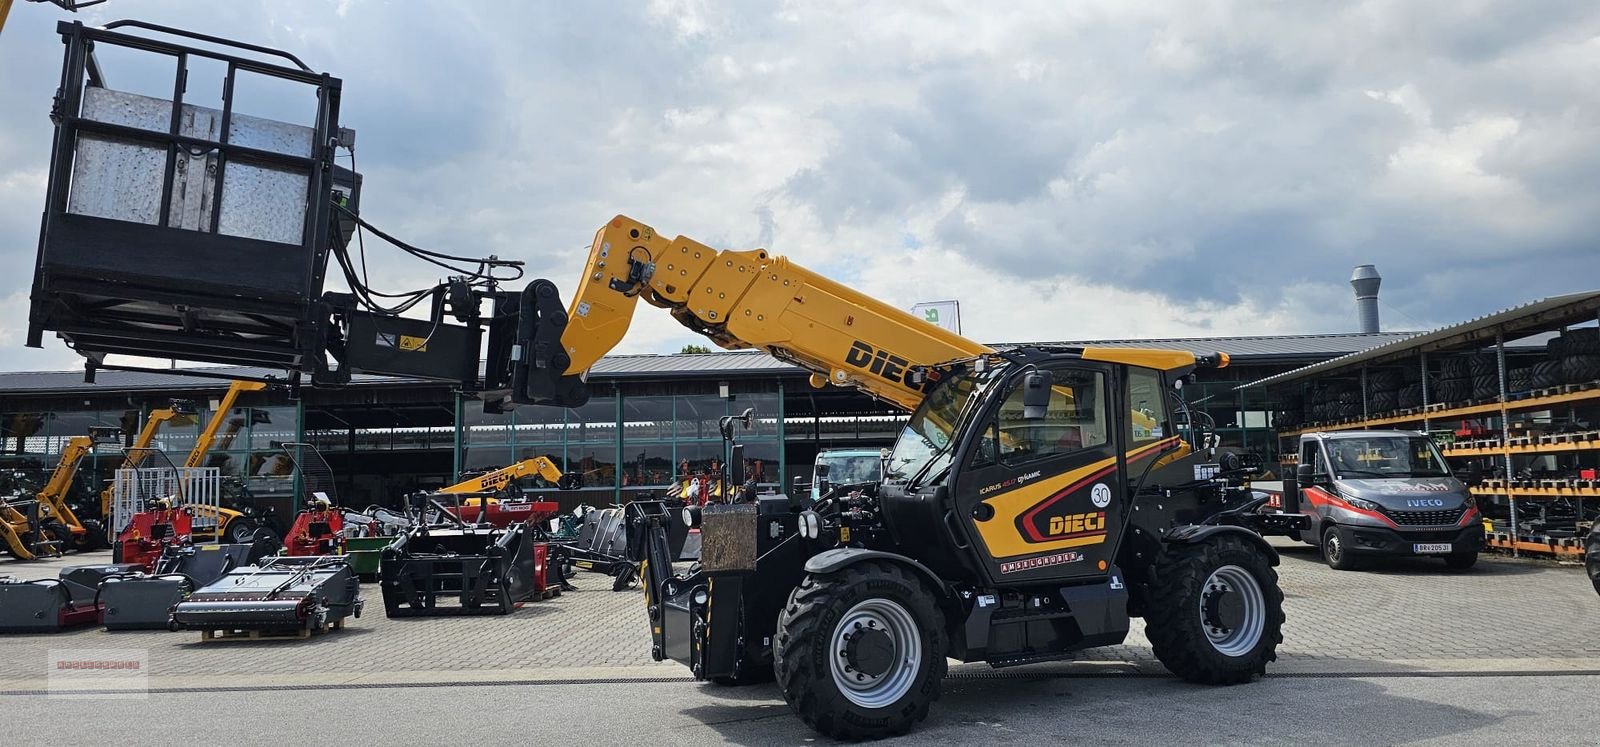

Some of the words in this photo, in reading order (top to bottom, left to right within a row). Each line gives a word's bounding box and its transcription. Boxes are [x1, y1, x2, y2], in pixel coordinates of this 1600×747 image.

[481, 471, 509, 488] DIECI
[979, 483, 1002, 495] ICARUS
[1093, 487, 1109, 504] 30
[1406, 499, 1443, 507] IVECO
[1049, 511, 1106, 535] DIECI
